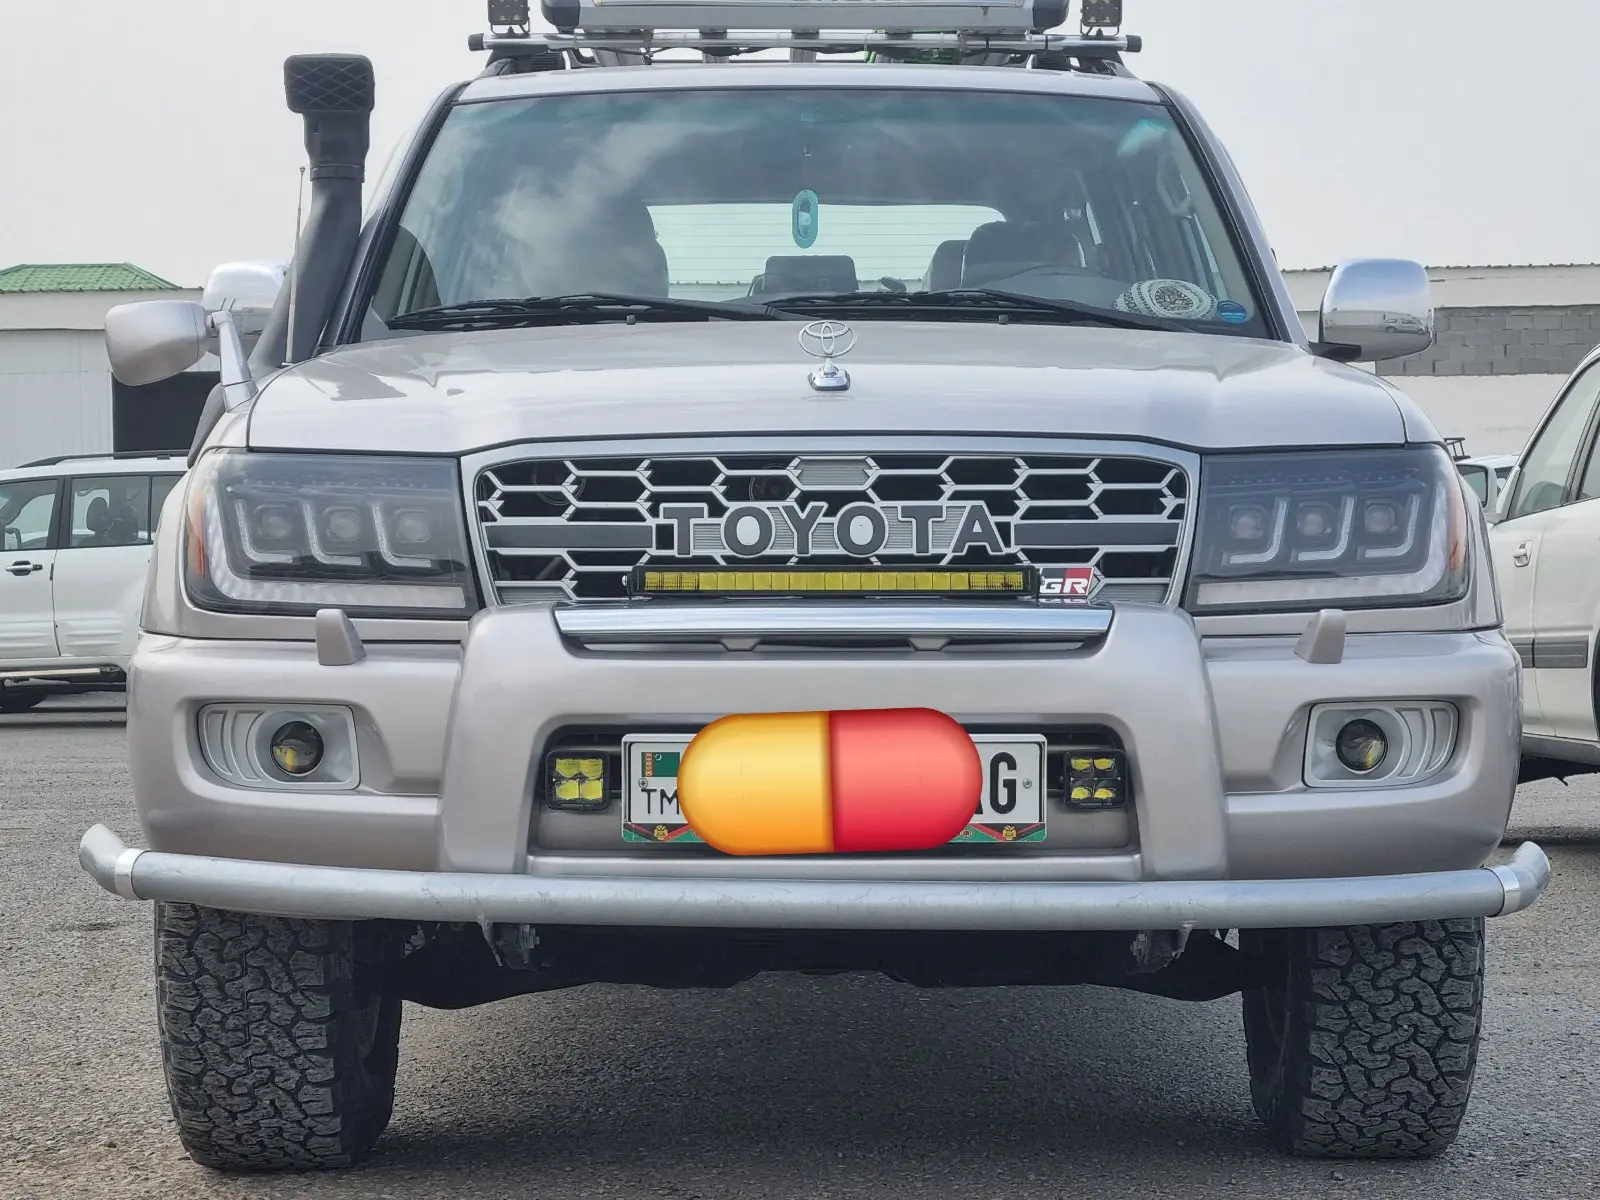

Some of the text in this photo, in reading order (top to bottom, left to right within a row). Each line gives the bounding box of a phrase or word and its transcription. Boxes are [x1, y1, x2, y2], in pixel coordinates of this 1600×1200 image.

[661, 502, 1004, 557] TOYOTA
[1039, 577, 1089, 594] GR
[640, 788, 680, 815] TM
